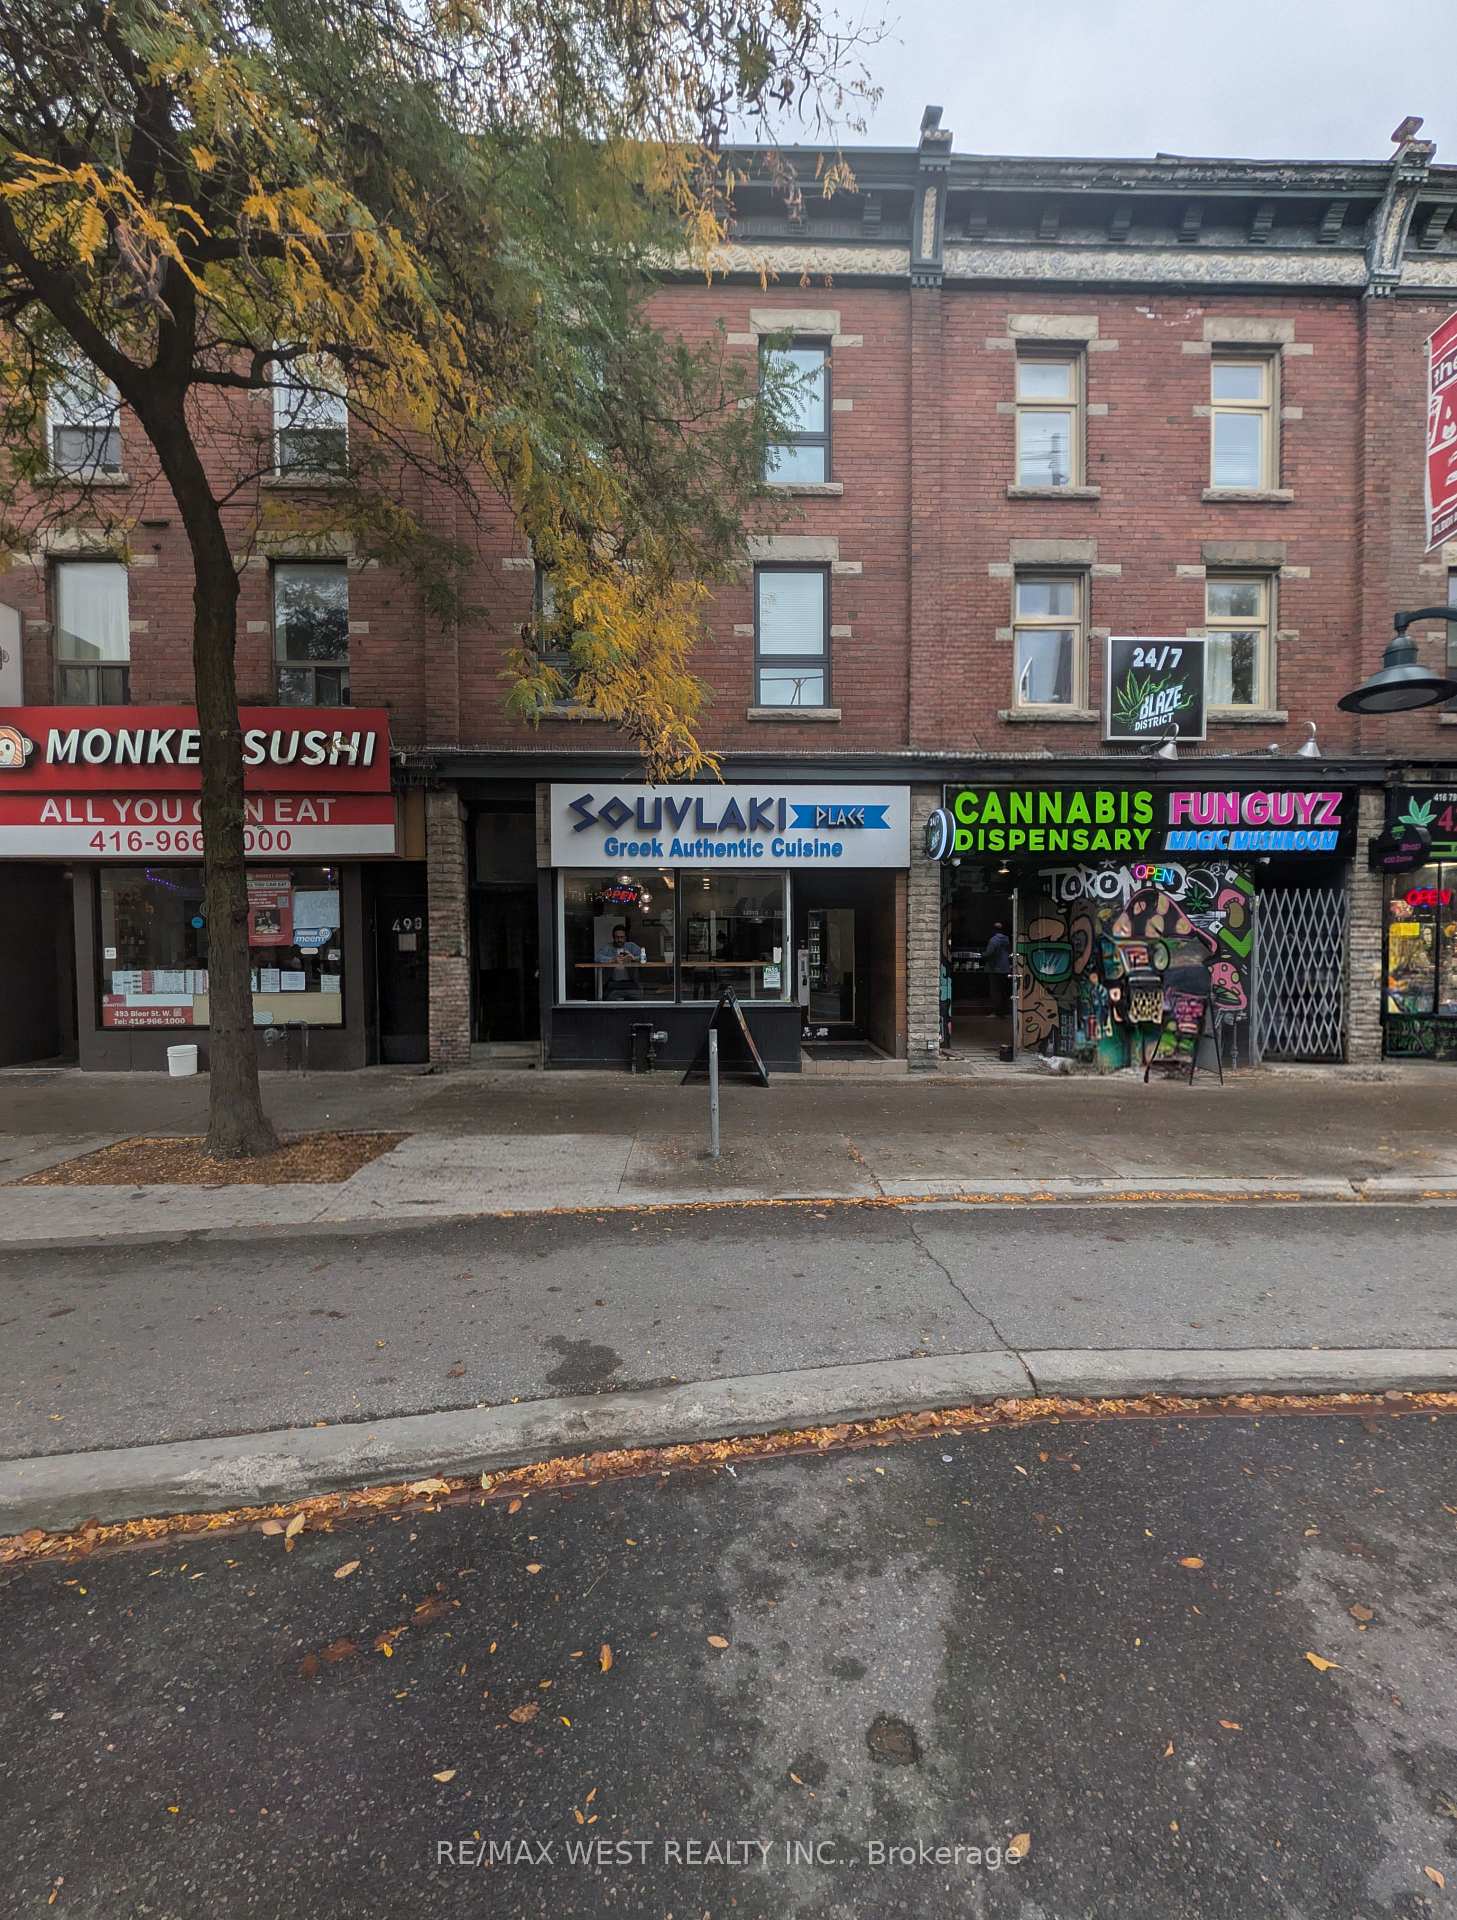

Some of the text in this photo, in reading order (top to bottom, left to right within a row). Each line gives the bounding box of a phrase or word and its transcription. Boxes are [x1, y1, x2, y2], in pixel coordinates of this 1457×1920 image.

[1133, 646, 1183, 671] 24/7
[1140, 684, 1184, 720] BLAZE
[1134, 712, 1175, 731] DISTRICT
[46, 728, 376, 766] MONKE SUSHI
[40, 798, 105, 823] ALL
[112, 798, 183, 823] YOU
[274, 798, 337, 823] EAT
[568, 793, 865, 834] SOUVLAKI PLACE
[954, 791, 1154, 824] CANNABIS
[89, 830, 292, 852] 416-966000
[604, 837, 843, 857] Greek Authentic Cuisine
[954, 828, 1153, 851] DISPENSARY
[1165, 830, 1230, 850] MAGIC
[1229, 830, 1339, 850] MUSHROOM
[1135, 864, 1175, 885] OPEN
[1406, 888, 1451, 906] OPEN
